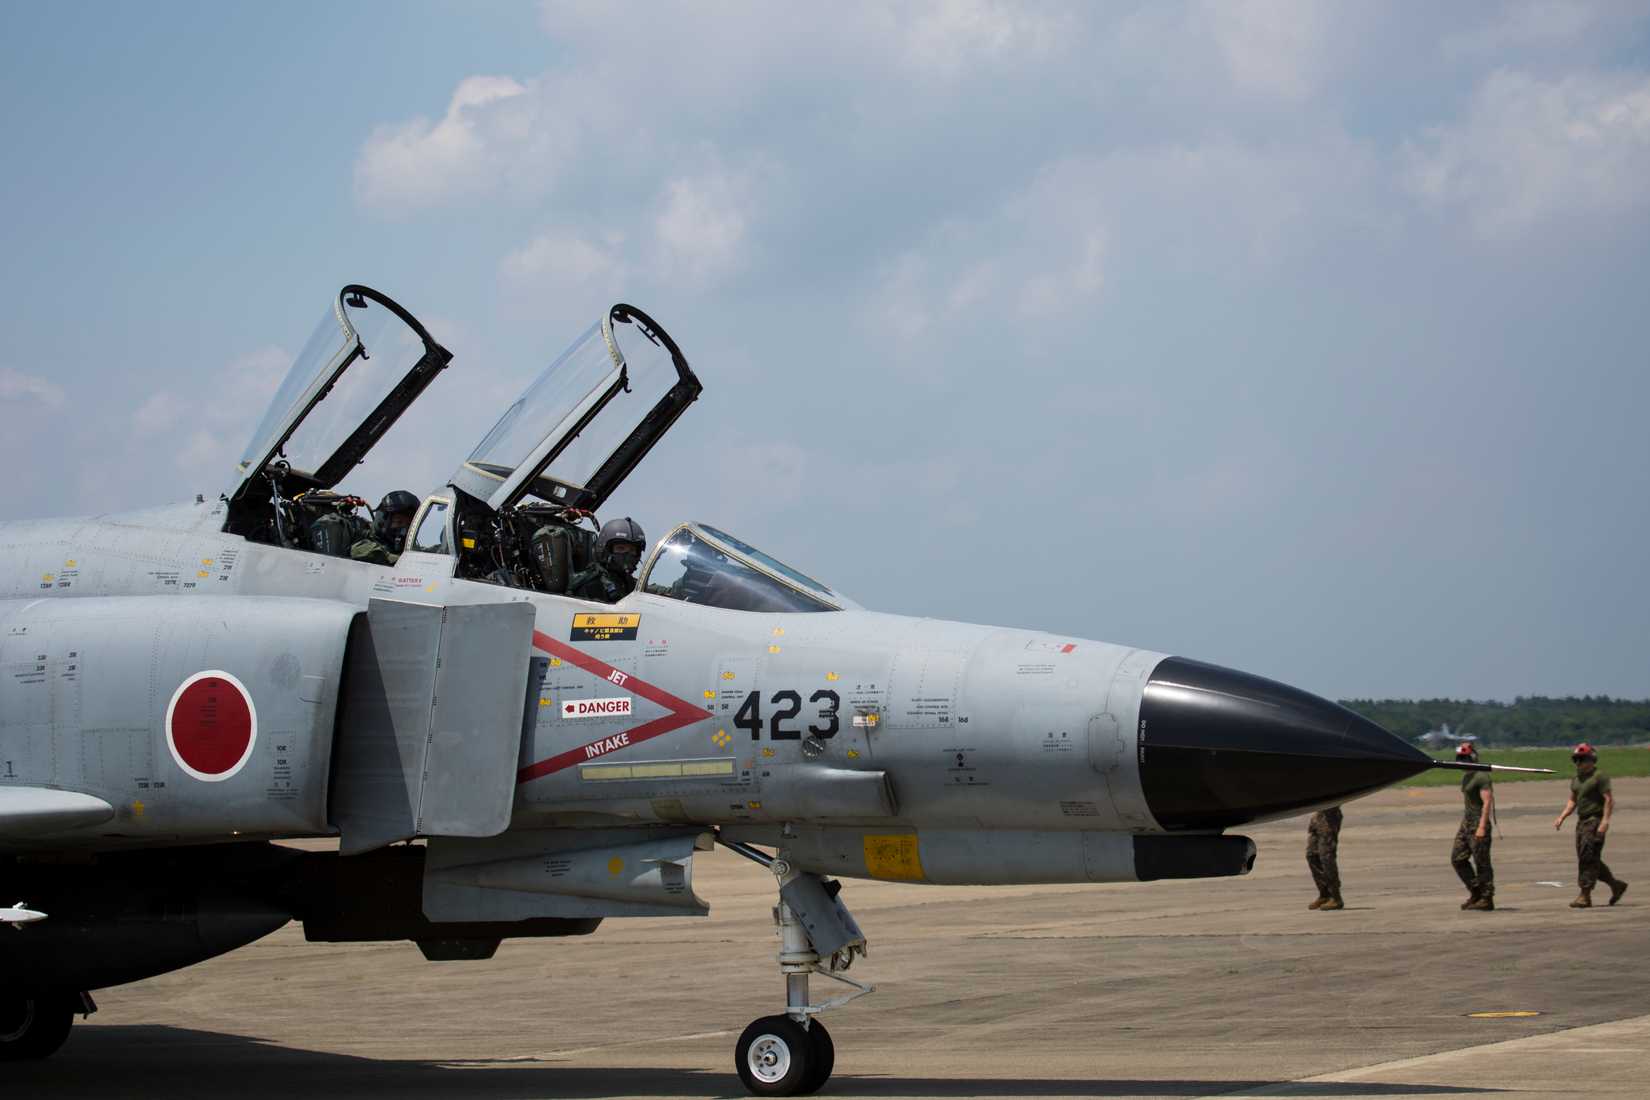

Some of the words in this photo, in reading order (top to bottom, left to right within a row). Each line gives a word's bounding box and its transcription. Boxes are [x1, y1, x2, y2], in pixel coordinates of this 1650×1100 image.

[607, 670, 628, 686] JET
[579, 701, 630, 714] DANGER
[733, 689, 840, 741] 423
[585, 733, 630, 759] INTAKE
